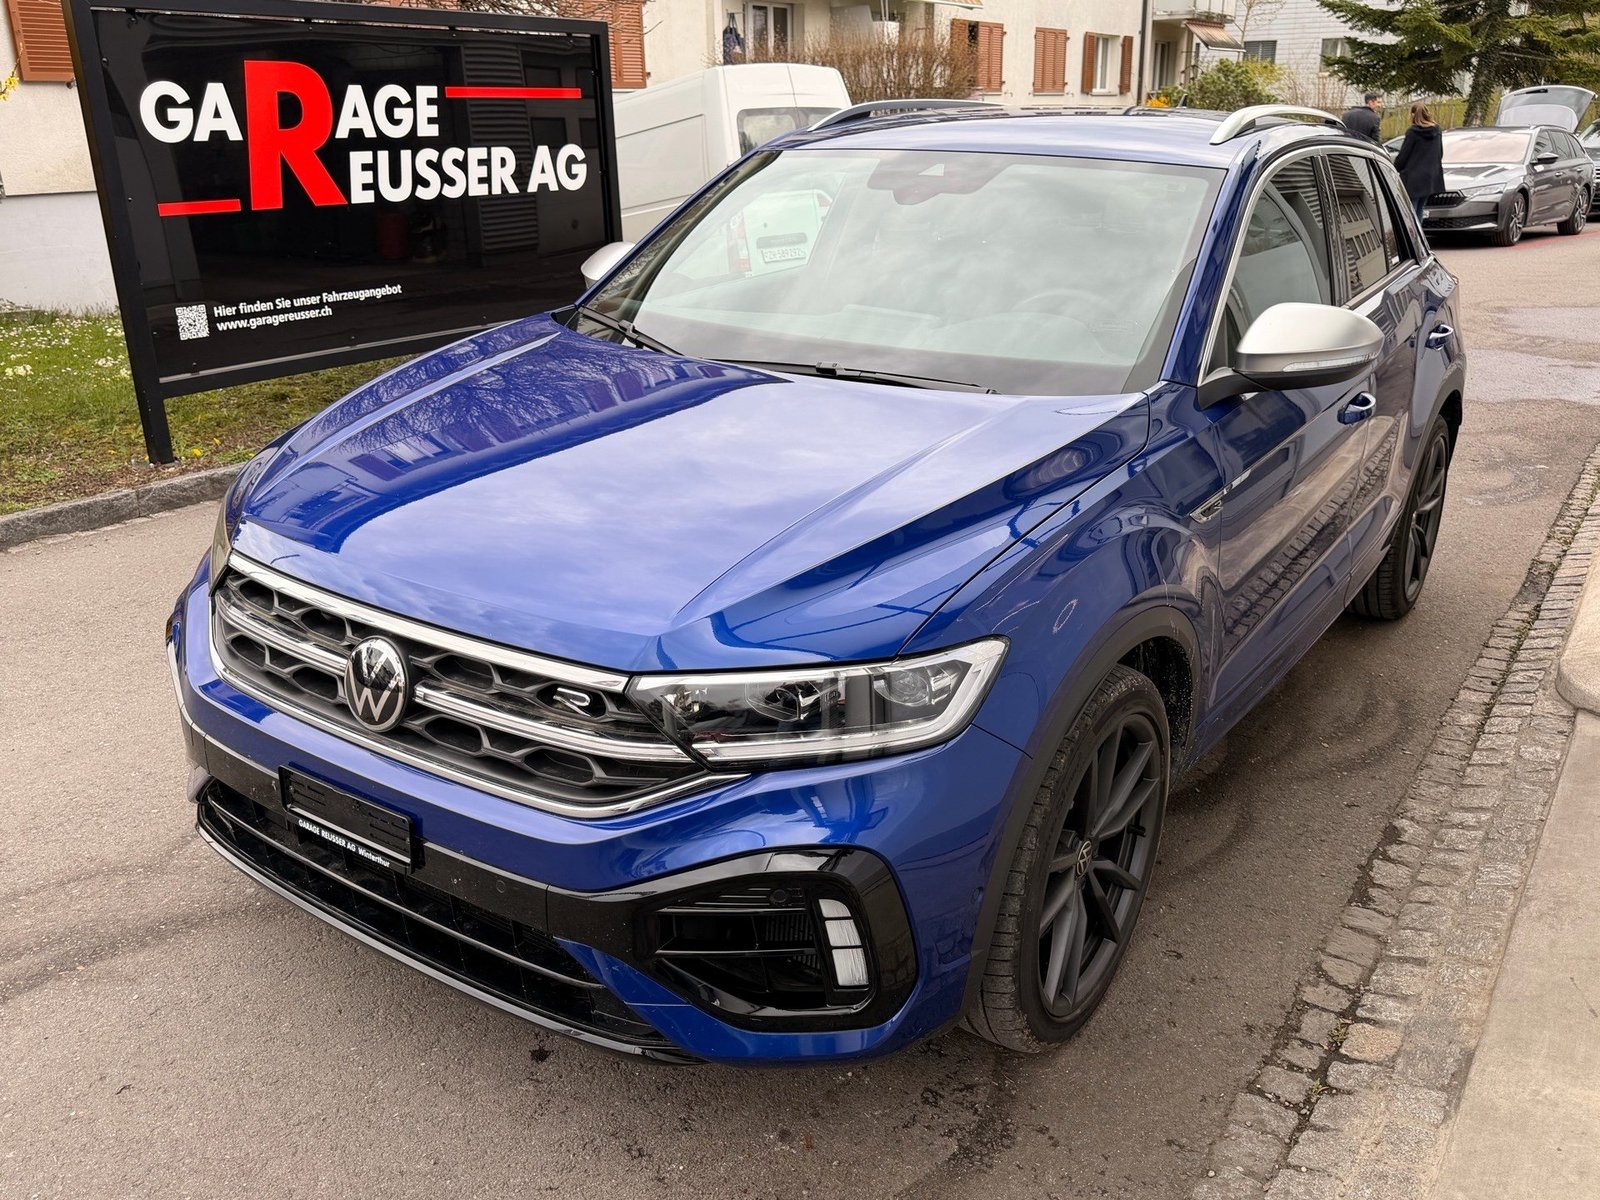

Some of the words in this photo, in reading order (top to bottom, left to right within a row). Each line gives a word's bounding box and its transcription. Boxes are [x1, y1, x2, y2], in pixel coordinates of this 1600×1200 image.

[139, 60, 439, 210] GARAGE
[527, 143, 588, 193] AG
[213, 304, 237, 318] Hier
[238, 299, 274, 315] finden
[275, 297, 292, 310] Sie
[293, 294, 321, 308] unser
[322, 283, 403, 305] Fahrzeugangebot
[216, 305, 333, 332] www.garagereusser.ch
[298, 818, 320, 836] GARAGE
[321, 829, 347, 848] REUSSER
[346, 841, 357, 852] AG
[358, 846, 391, 868] Winterthur
